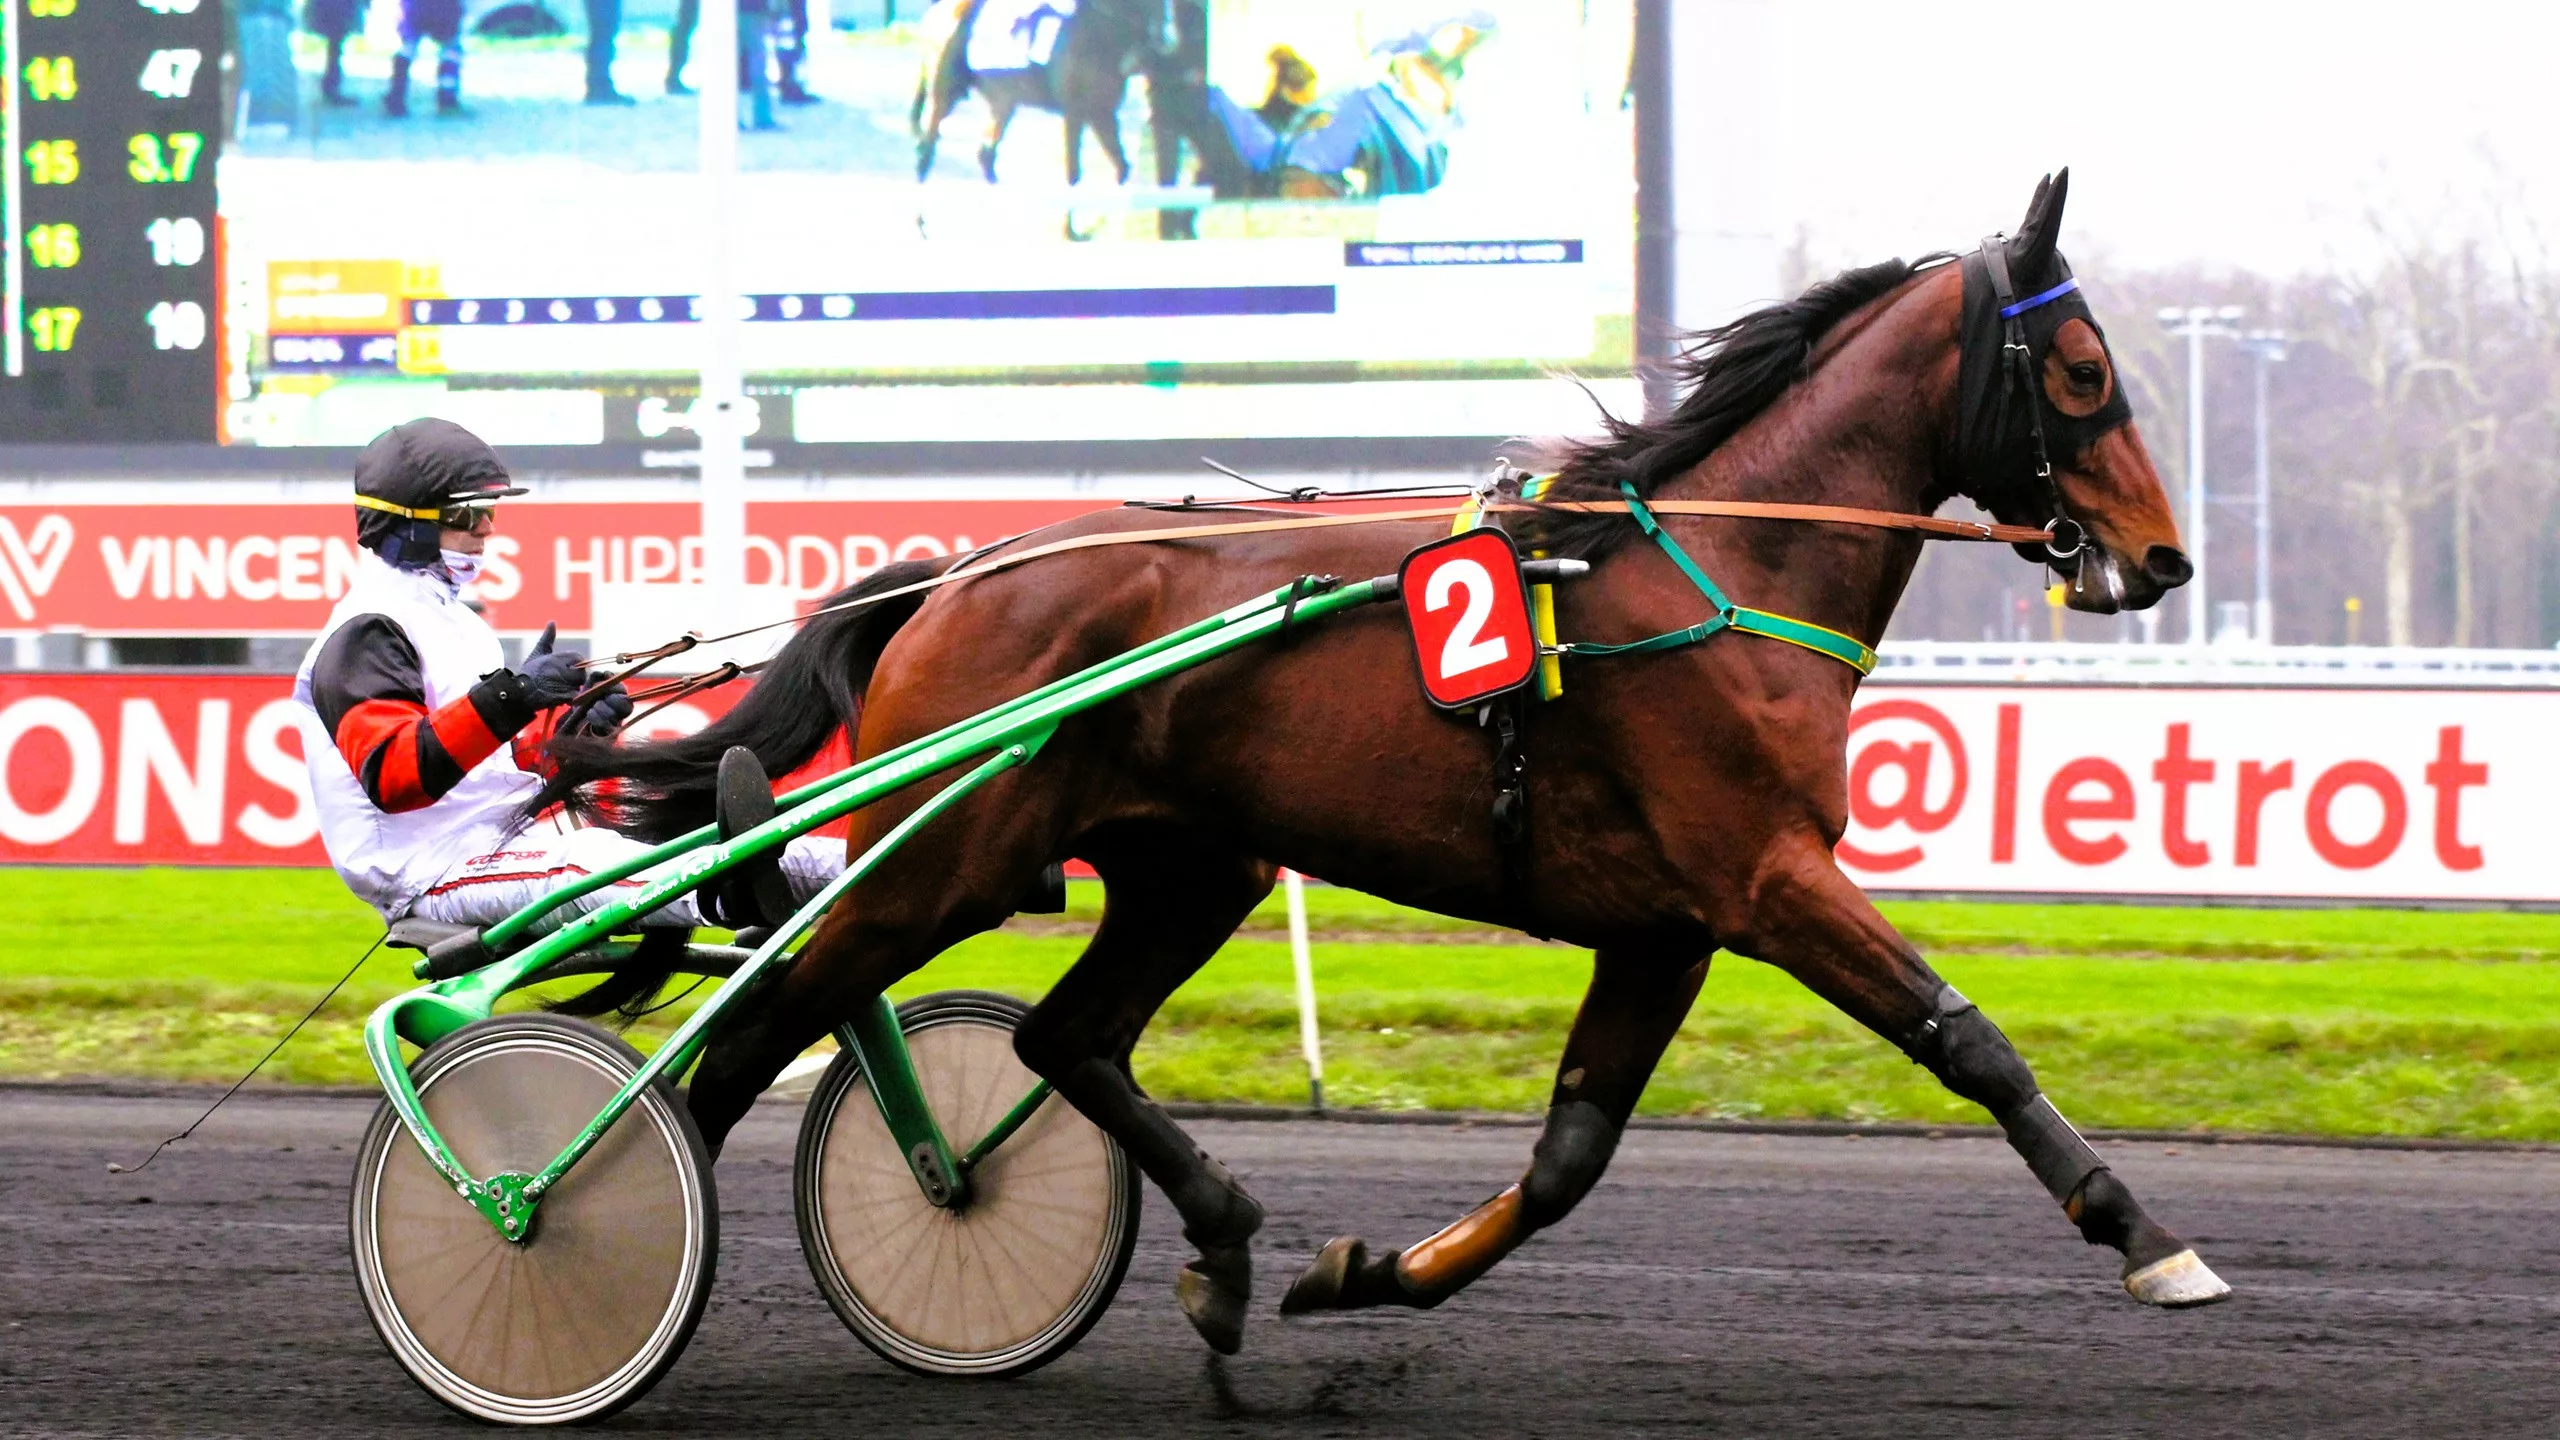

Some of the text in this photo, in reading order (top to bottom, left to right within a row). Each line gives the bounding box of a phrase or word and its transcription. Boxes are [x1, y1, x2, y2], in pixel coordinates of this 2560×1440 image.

[24, 56, 78, 101] 14
[24, 132, 203, 184] 15 3.7
[29, 307, 81, 351] 17
[99, 535, 522, 601] VINCENS
[1424, 558, 1508, 679] 2
[1834, 699, 2489, 873] @letrot
